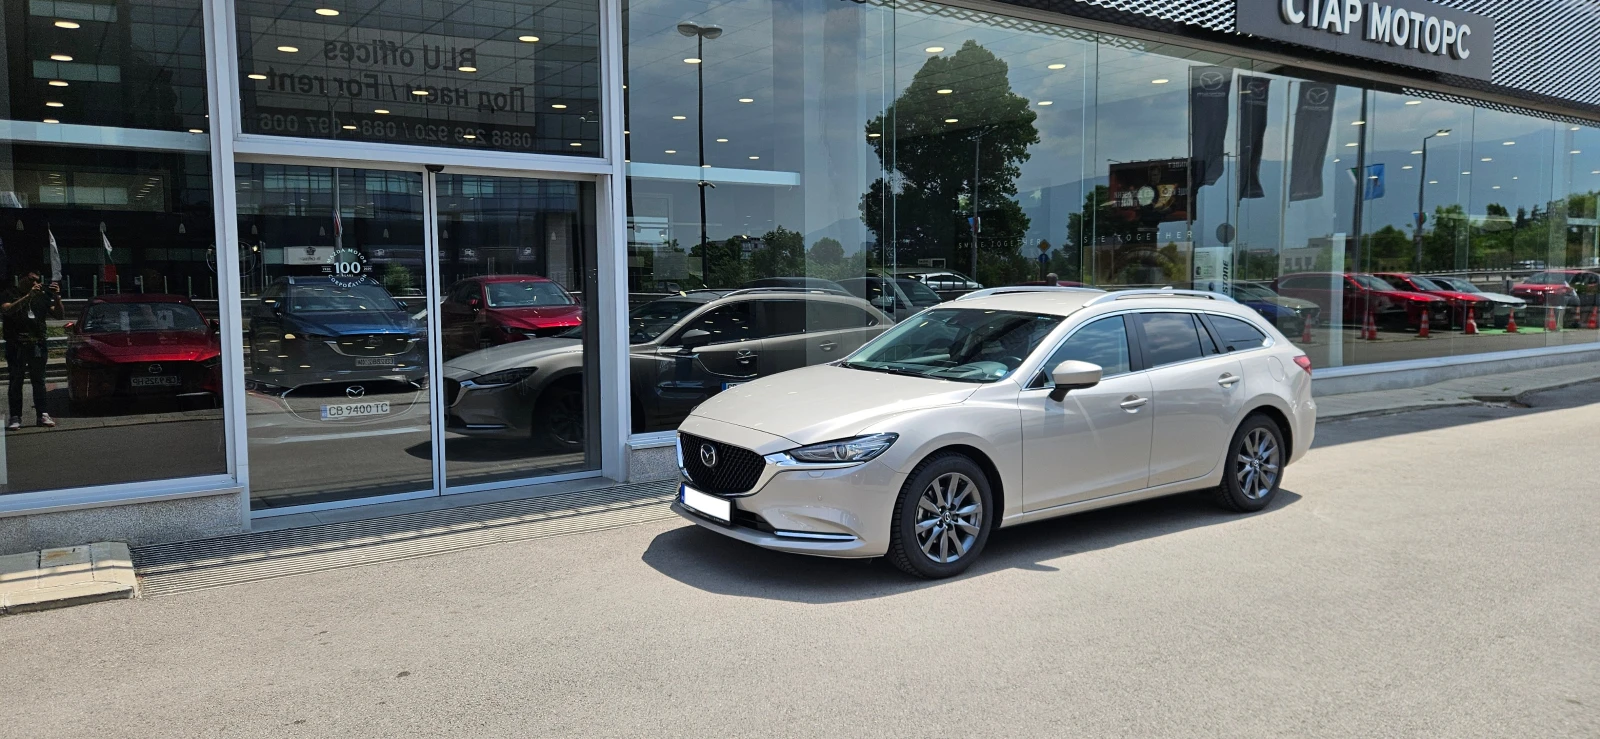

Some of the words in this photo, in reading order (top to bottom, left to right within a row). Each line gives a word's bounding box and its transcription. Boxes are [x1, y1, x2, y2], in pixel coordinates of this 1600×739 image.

[1366, 2, 1471, 60] МОТОРС
[1117, 231, 1193, 243] TOGETHER
[326, 248, 346, 264] MAZDA
[347, 248, 367, 264] MOTOR
[333, 261, 361, 274] 100
[328, 274, 368, 288] CORPORATION
[328, 406, 344, 416] CB
[345, 404, 372, 415] 9400
[373, 402, 389, 413] TC
